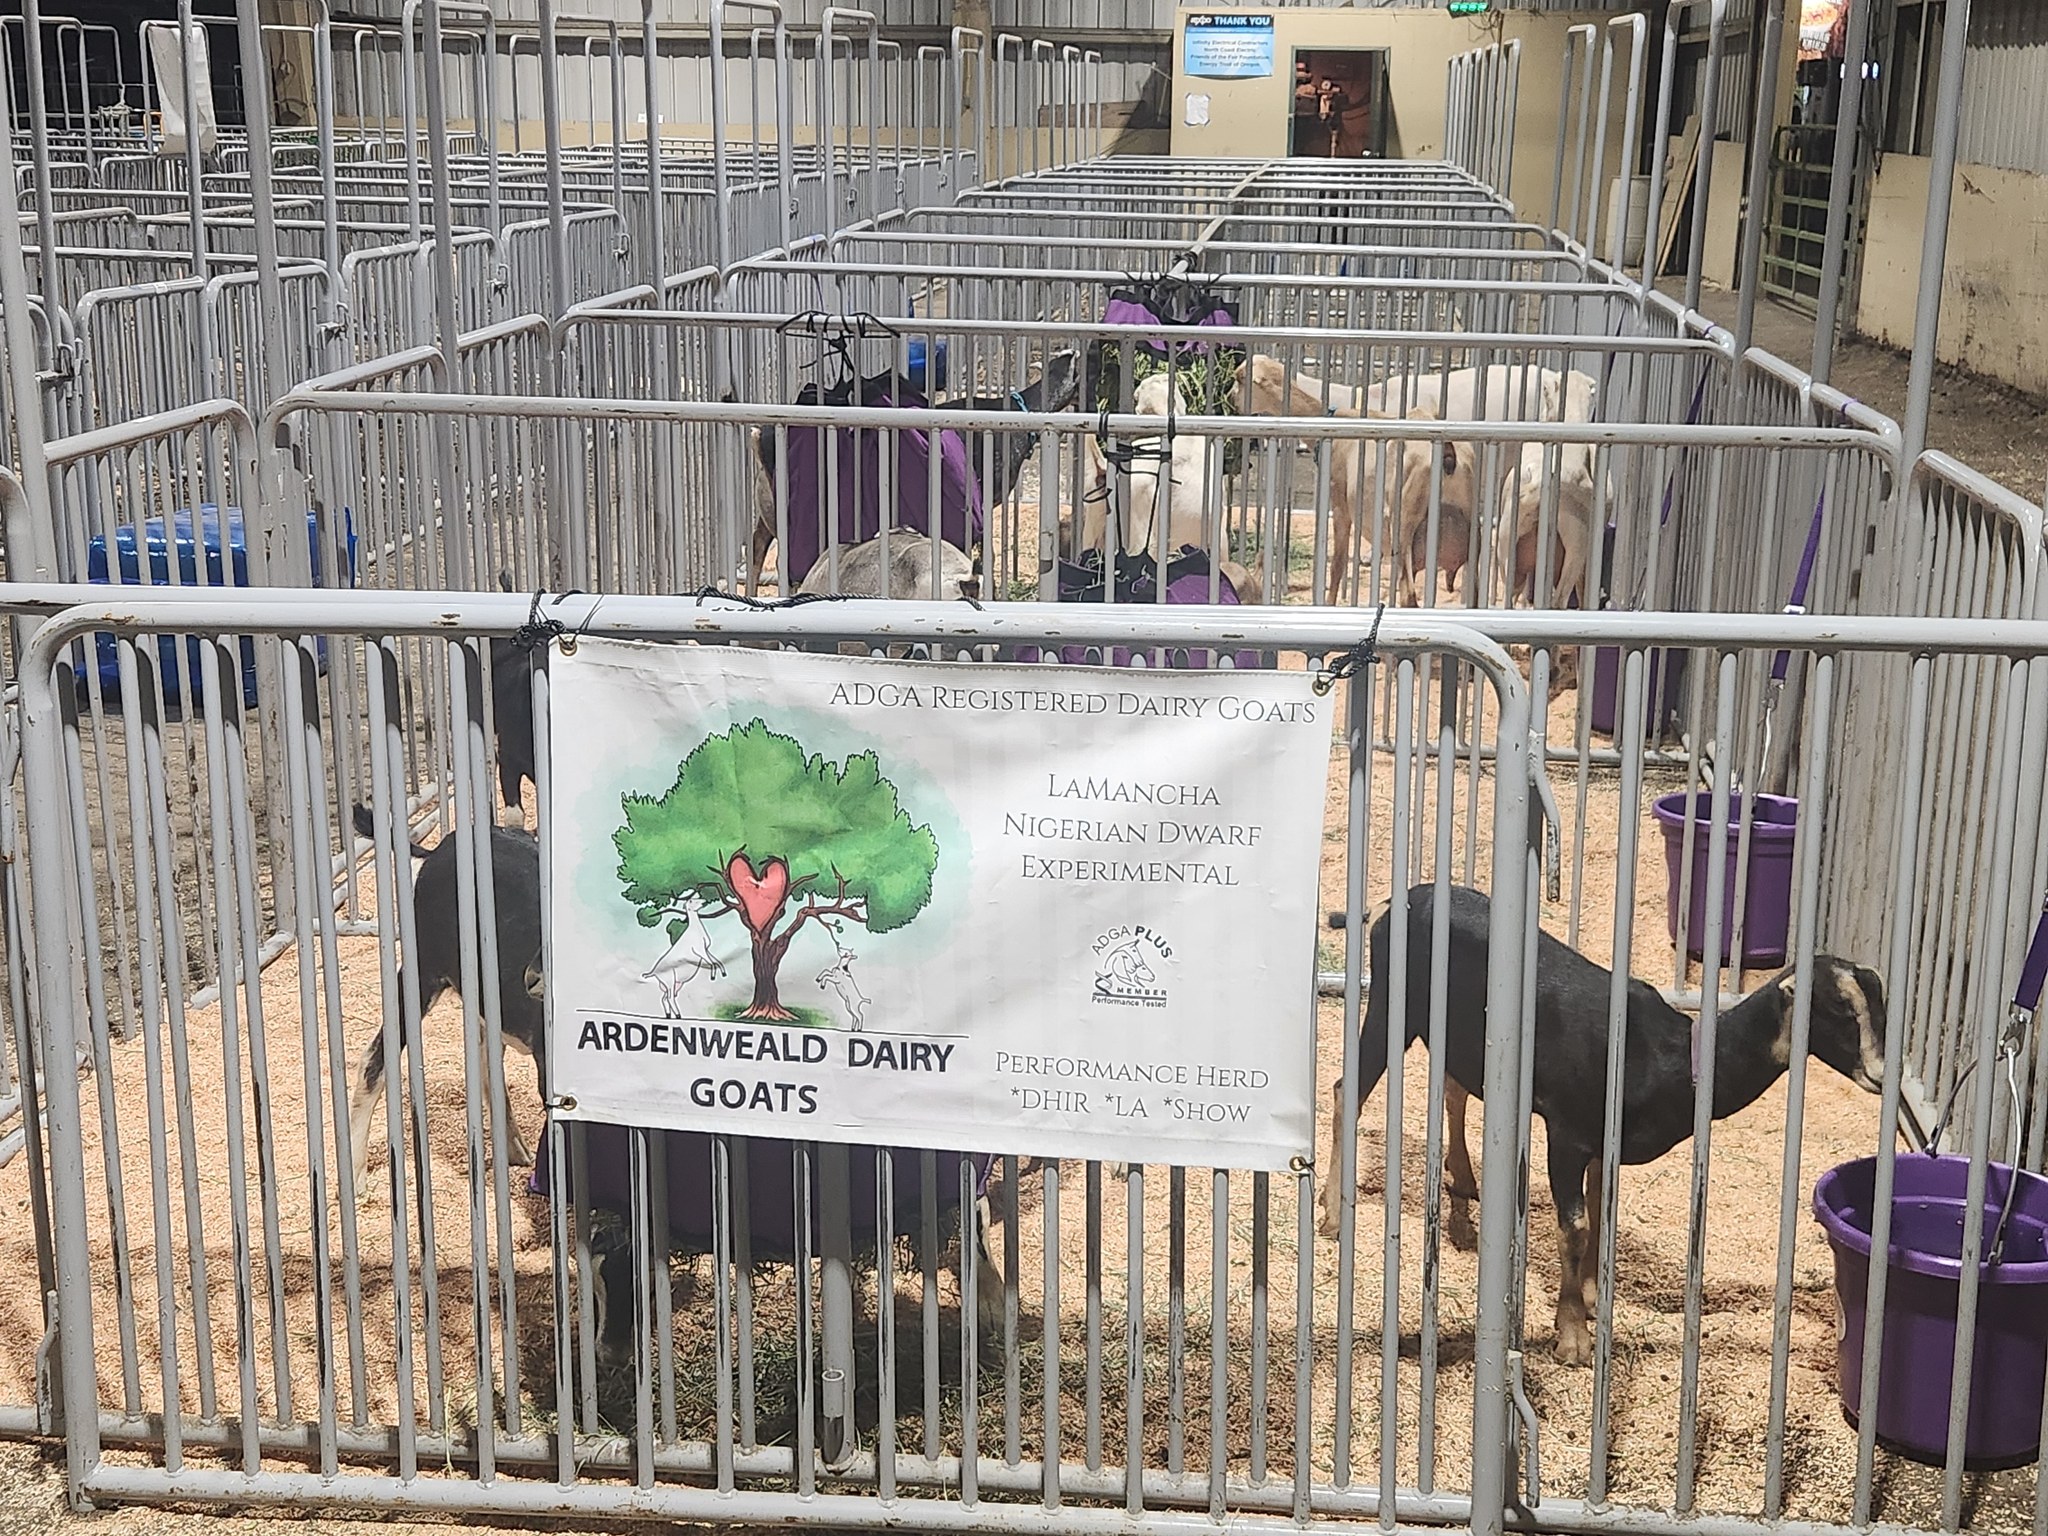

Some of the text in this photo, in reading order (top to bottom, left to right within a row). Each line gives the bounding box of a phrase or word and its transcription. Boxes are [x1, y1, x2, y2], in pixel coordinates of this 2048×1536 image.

[1214, 16, 1247, 25] THANK
[1249, 16, 1270, 26] YOU
[829, 682, 924, 709] ADGA
[1091, 925, 1173, 959] ADGA PLUS
[1091, 996, 1168, 1008] Performance Tested
[1116, 987, 1168, 996] MEMBER
[577, 1020, 955, 1073] ARDENWEALD DAIRY
[689, 1077, 819, 1115] GOATS
